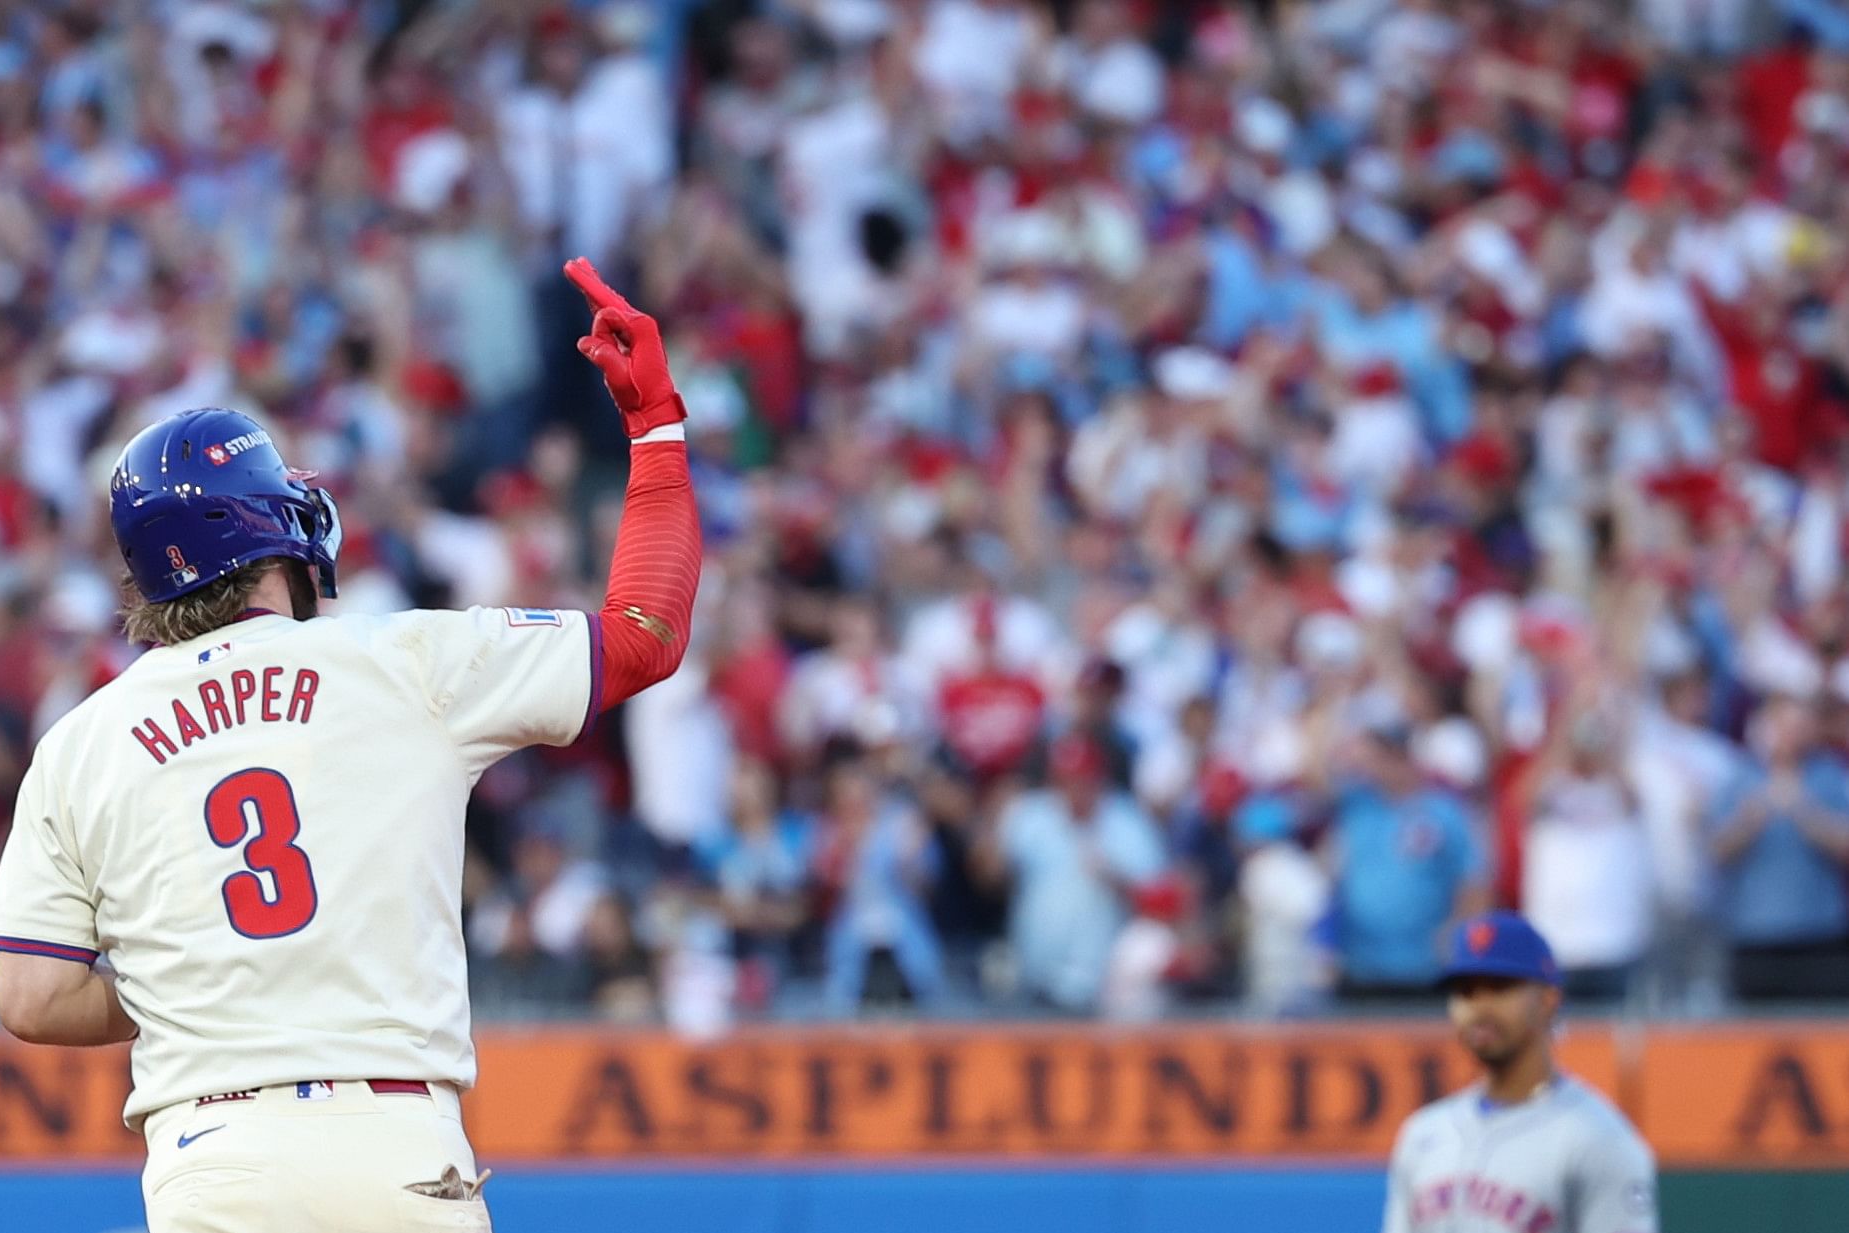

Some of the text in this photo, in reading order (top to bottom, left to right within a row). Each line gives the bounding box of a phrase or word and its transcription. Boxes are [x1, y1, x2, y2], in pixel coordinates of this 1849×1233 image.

[166, 545, 185, 569] 3
[131, 666, 319, 764] HARPER
[204, 767, 318, 939] 3
